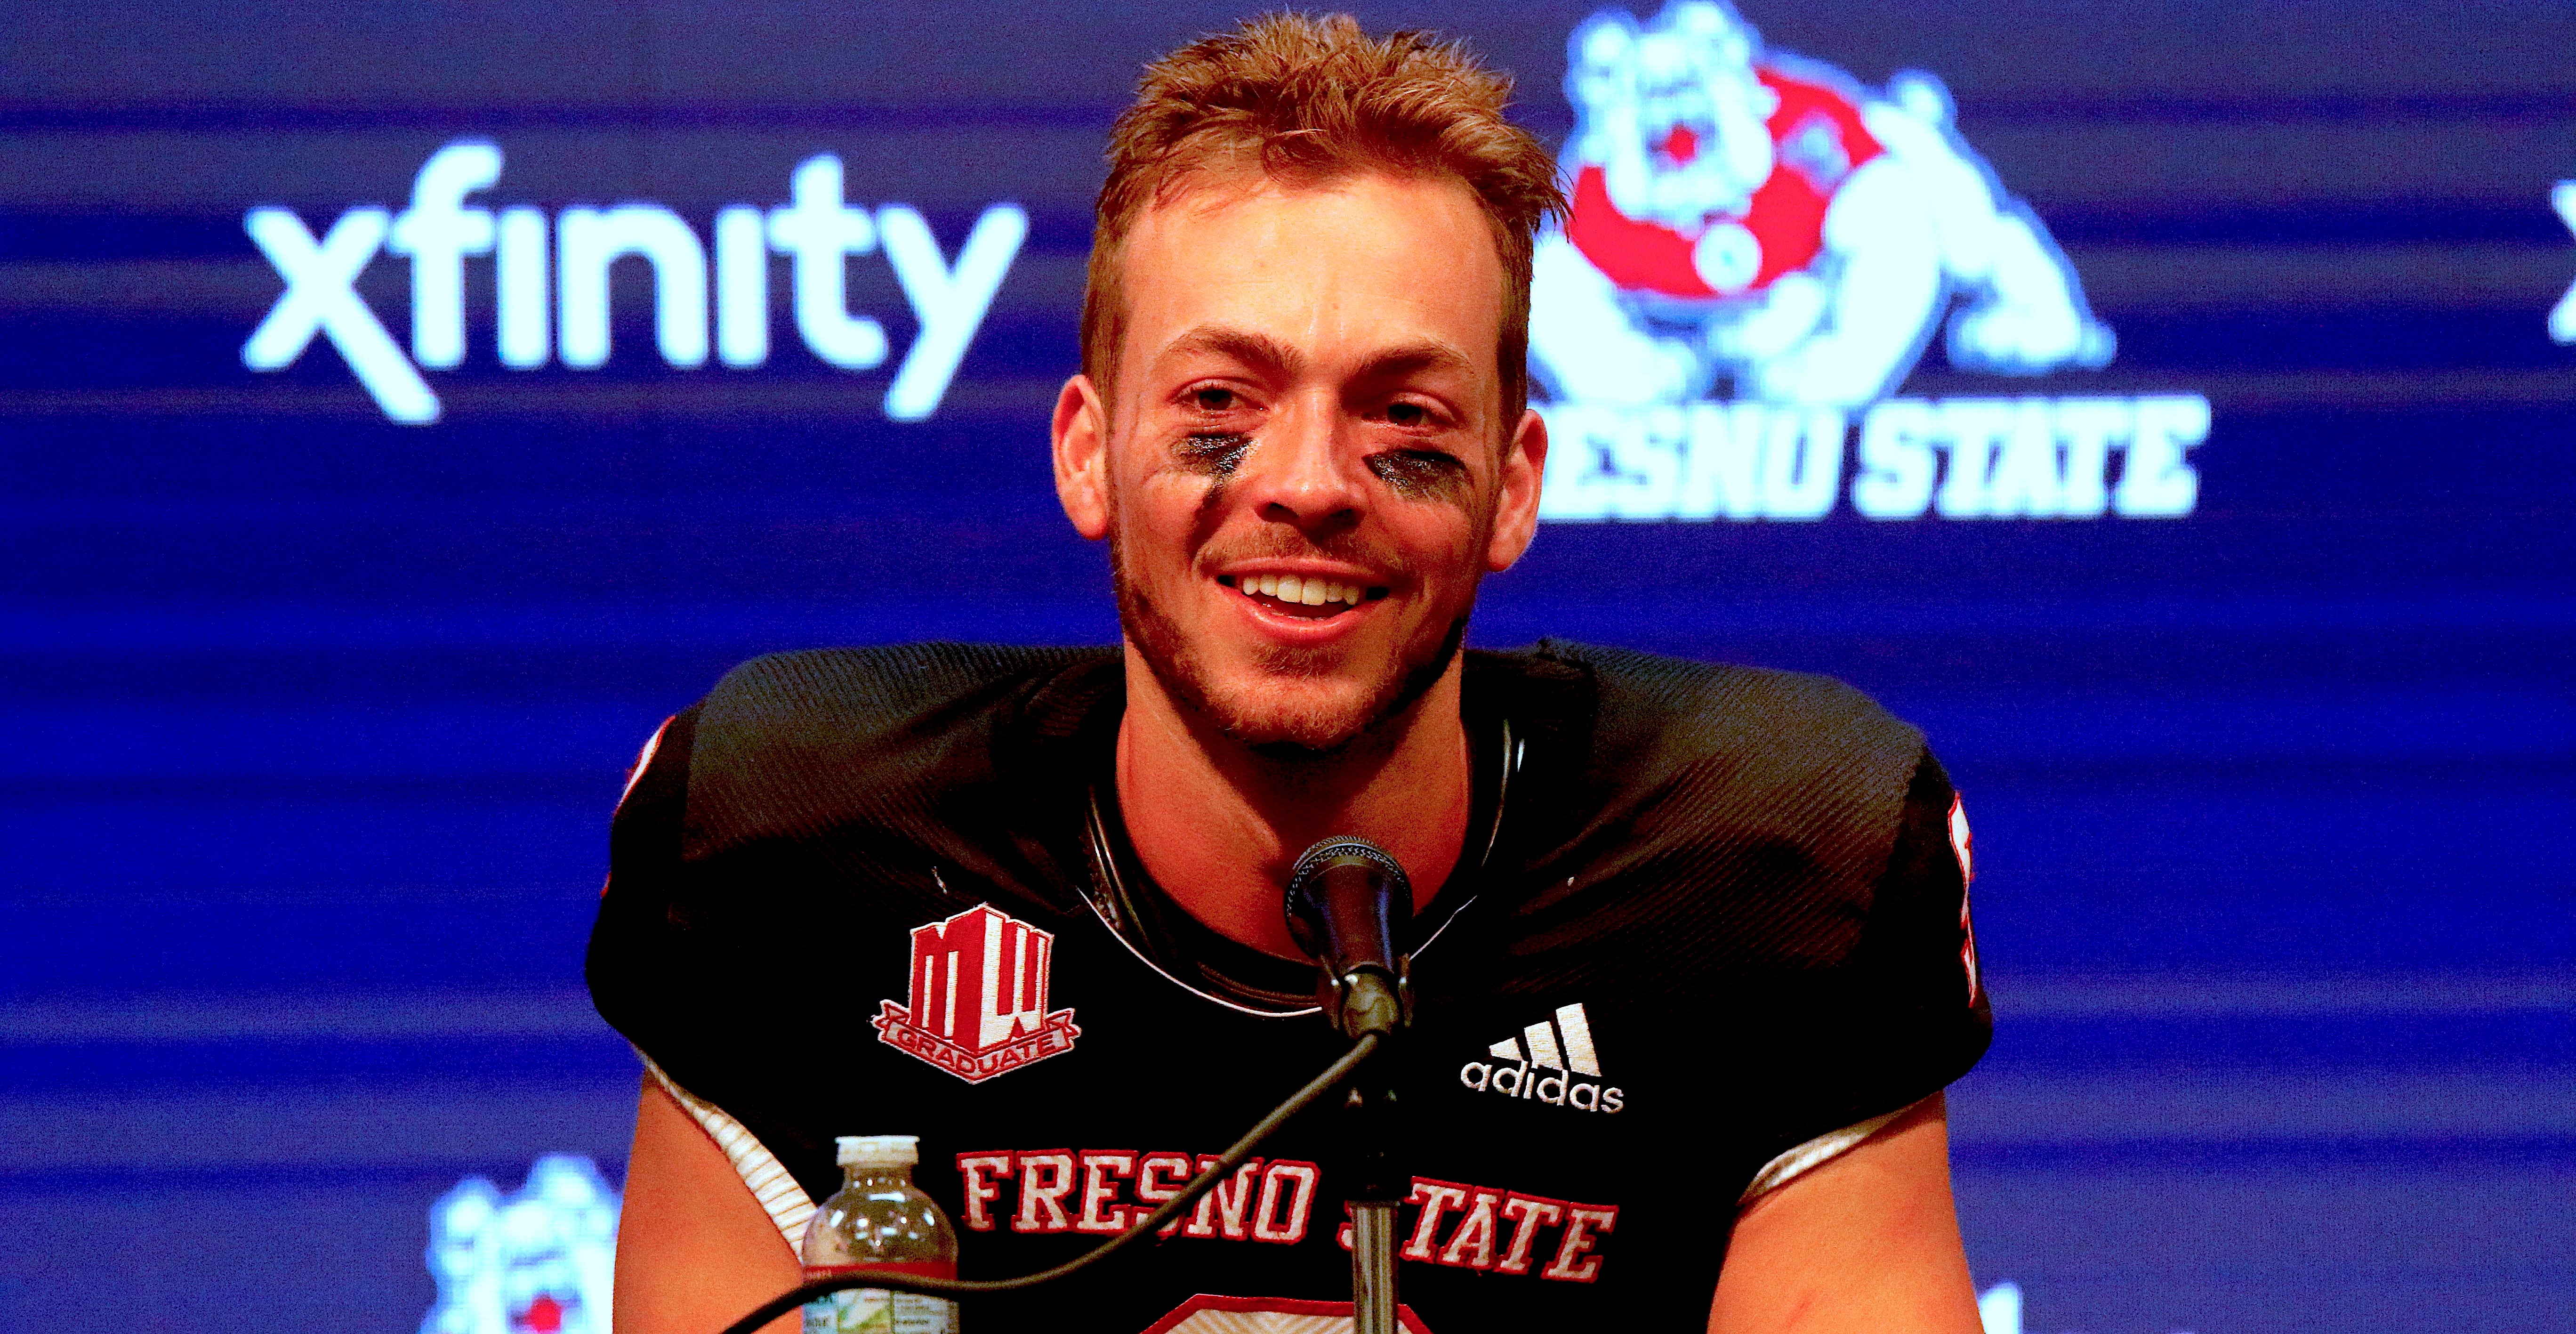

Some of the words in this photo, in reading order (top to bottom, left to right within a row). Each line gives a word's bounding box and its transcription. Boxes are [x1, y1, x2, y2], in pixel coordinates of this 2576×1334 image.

[243, 140, 1027, 422] xfinity
[1528, 398, 1845, 521] ESNO
[1852, 397, 2211, 520] STATE
[910, 908, 1048, 1053] MW
[897, 1029, 1055, 1073] GRADUATE
[1460, 1060, 1624, 1114] adidas
[1336, 1176, 1618, 1283] TATE
